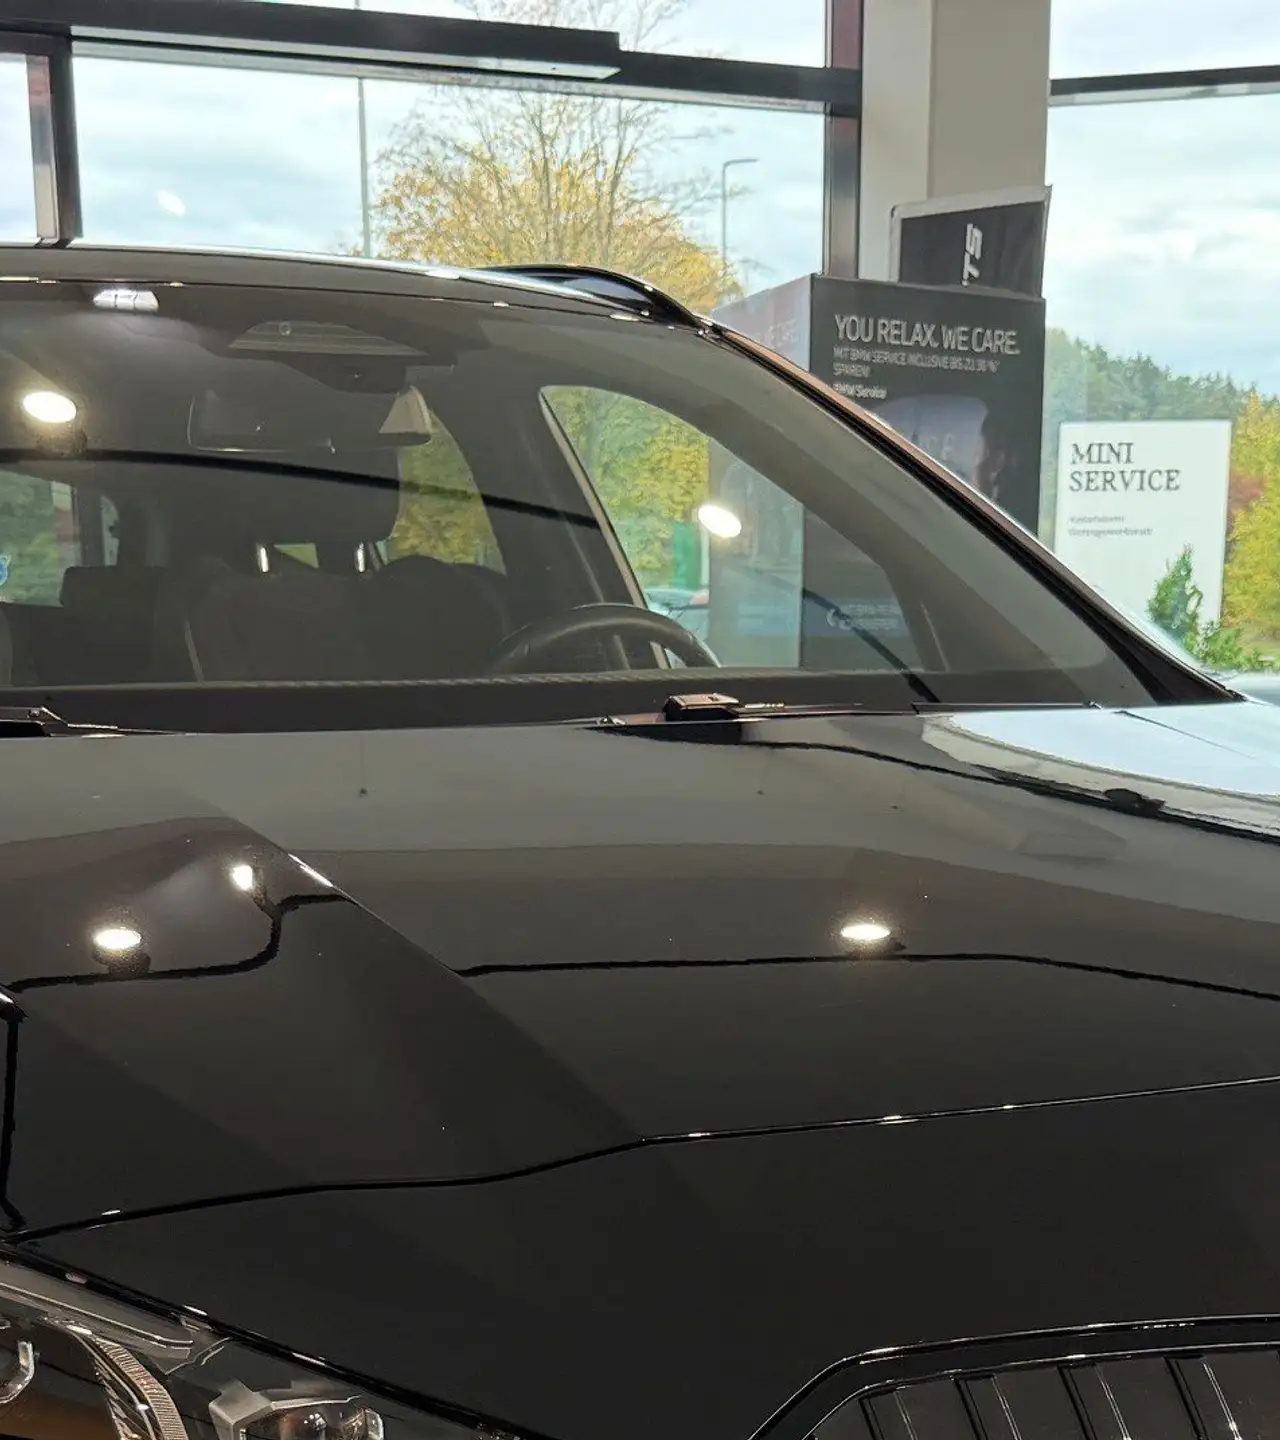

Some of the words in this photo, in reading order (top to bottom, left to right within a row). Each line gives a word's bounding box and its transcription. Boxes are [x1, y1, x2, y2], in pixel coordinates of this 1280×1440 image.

[834, 314, 874, 343] YOU
[877, 319, 940, 349] RELAX.
[941, 324, 969, 351] WE
[972, 328, 1021, 355] CARE.
[1071, 442, 1134, 465] MINI
[1068, 469, 1182, 492] SERVICE
